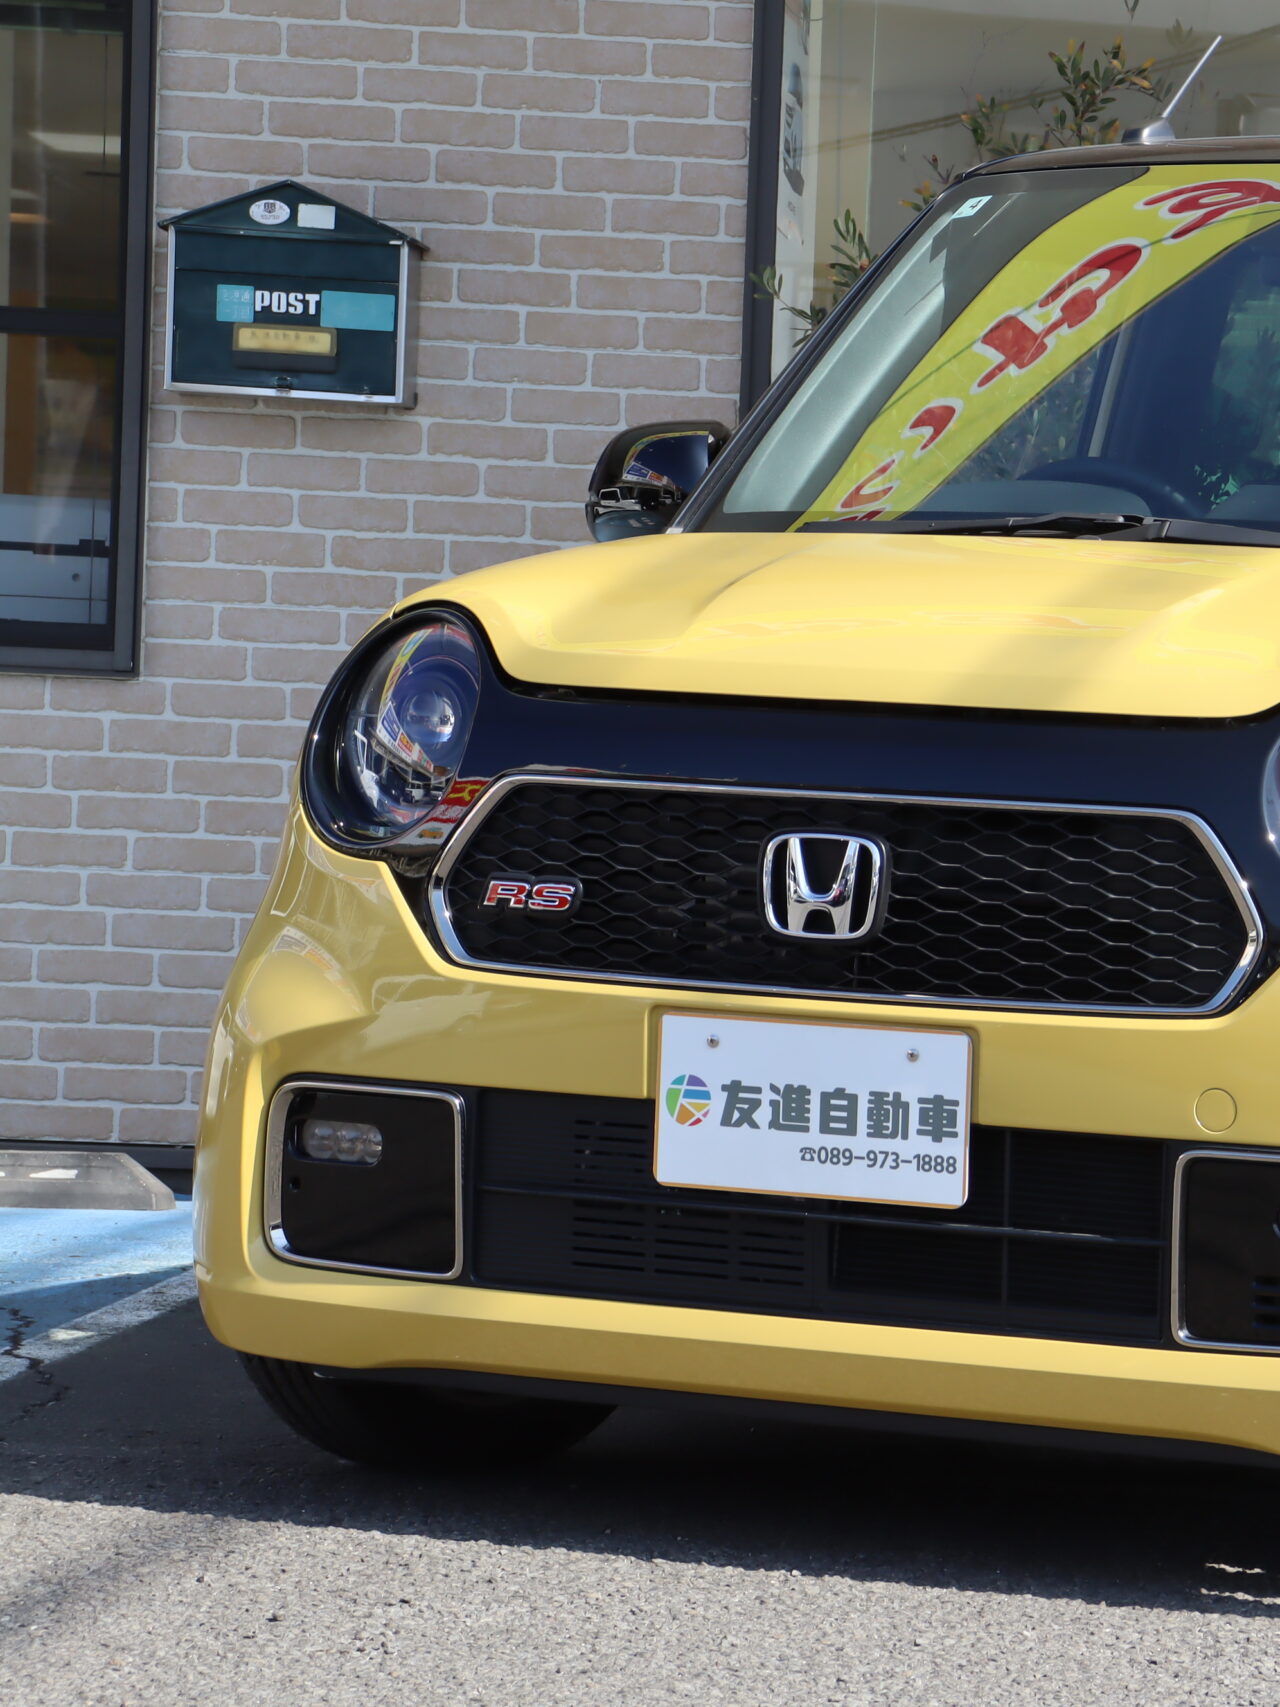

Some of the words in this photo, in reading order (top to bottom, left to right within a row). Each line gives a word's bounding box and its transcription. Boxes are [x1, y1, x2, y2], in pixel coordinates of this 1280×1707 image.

[254, 289, 321, 316] POST
[482, 879, 577, 912] RS
[719, 1079, 960, 1143] 友進自動車
[817, 1145, 958, 1175] 089-973-1888
